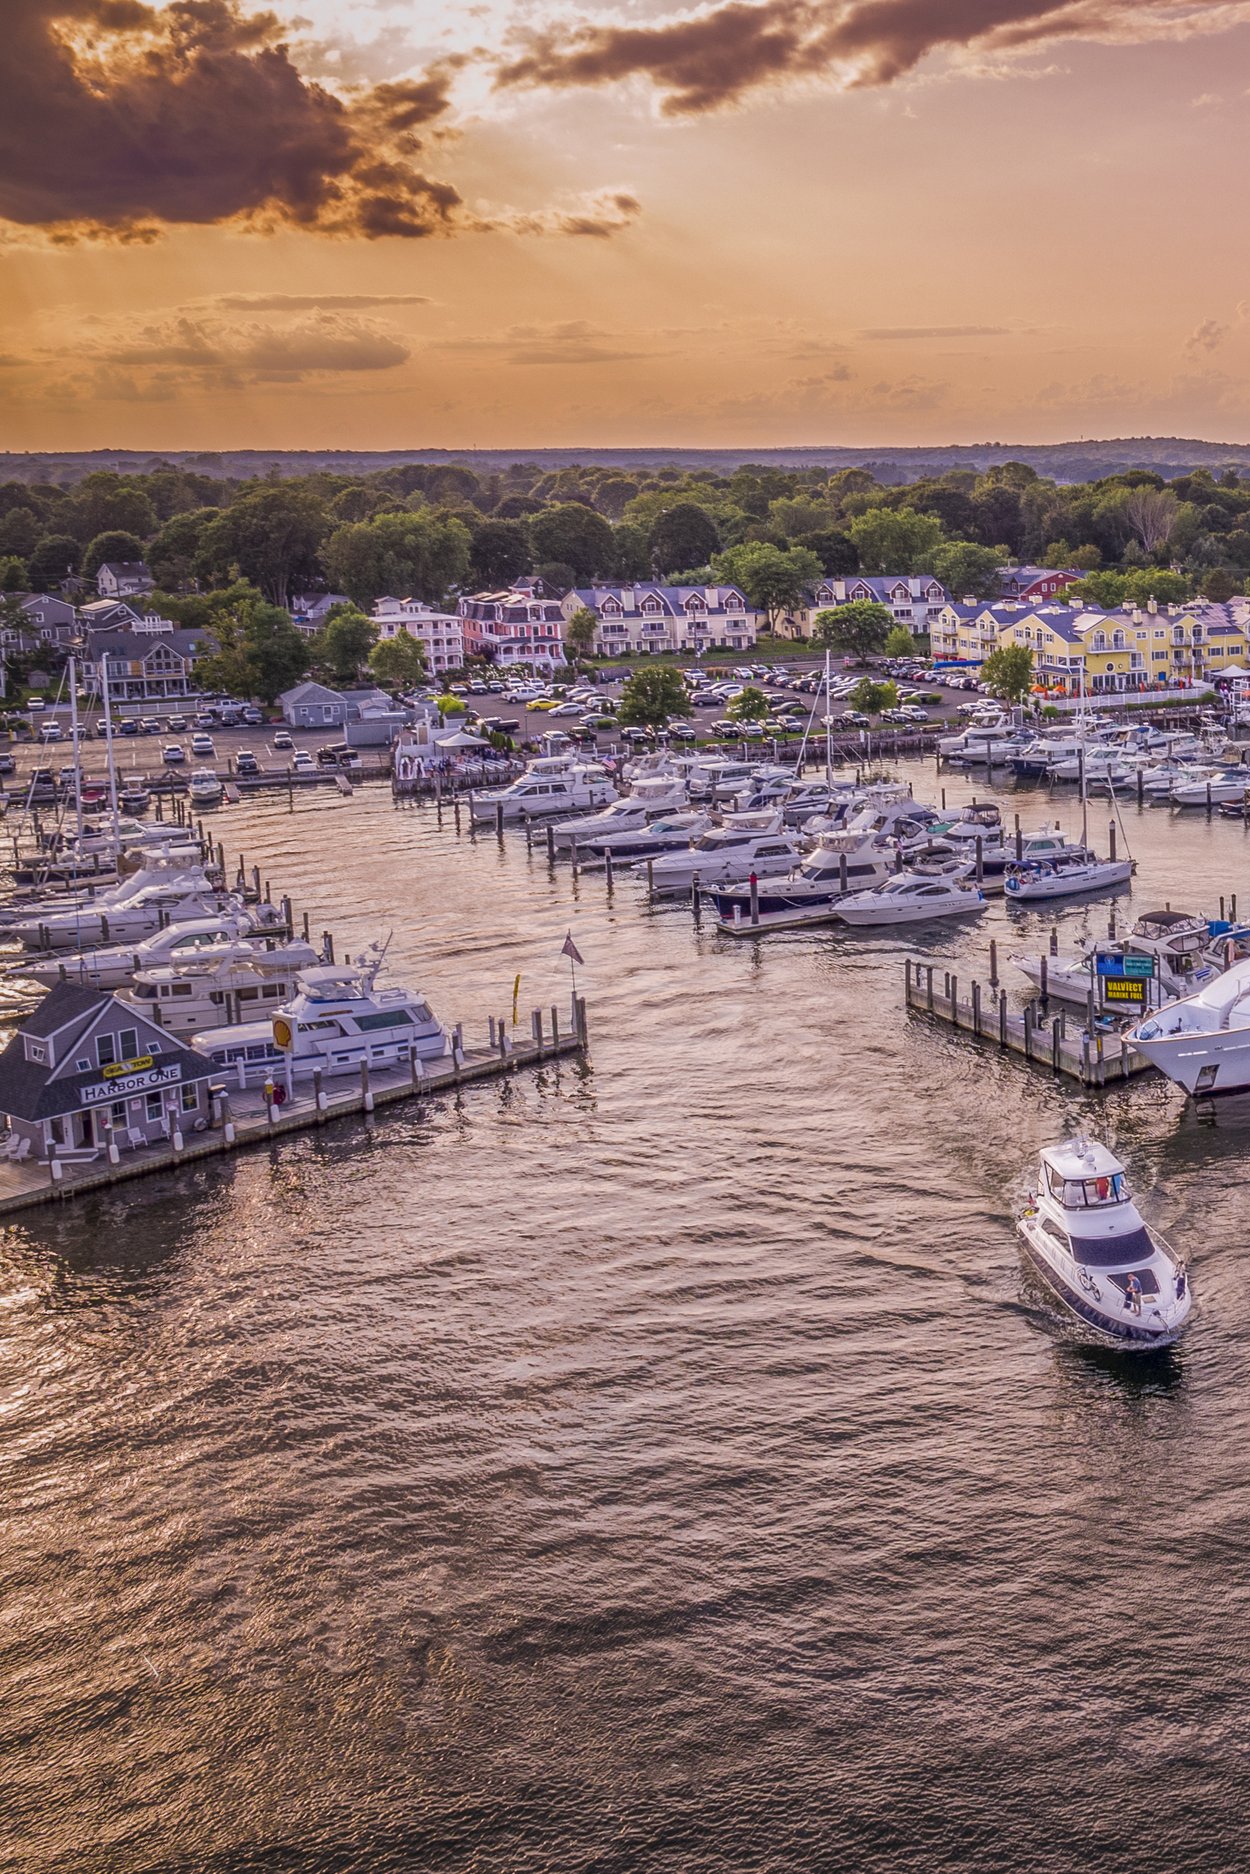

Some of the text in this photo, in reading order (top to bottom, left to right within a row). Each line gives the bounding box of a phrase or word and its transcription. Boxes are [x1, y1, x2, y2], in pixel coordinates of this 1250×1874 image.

[1107, 991, 1143, 1000] MARINE FUEL
[134, 1058, 151, 1068] TOW
[85, 1068, 178, 1100] HARBOR ONE
